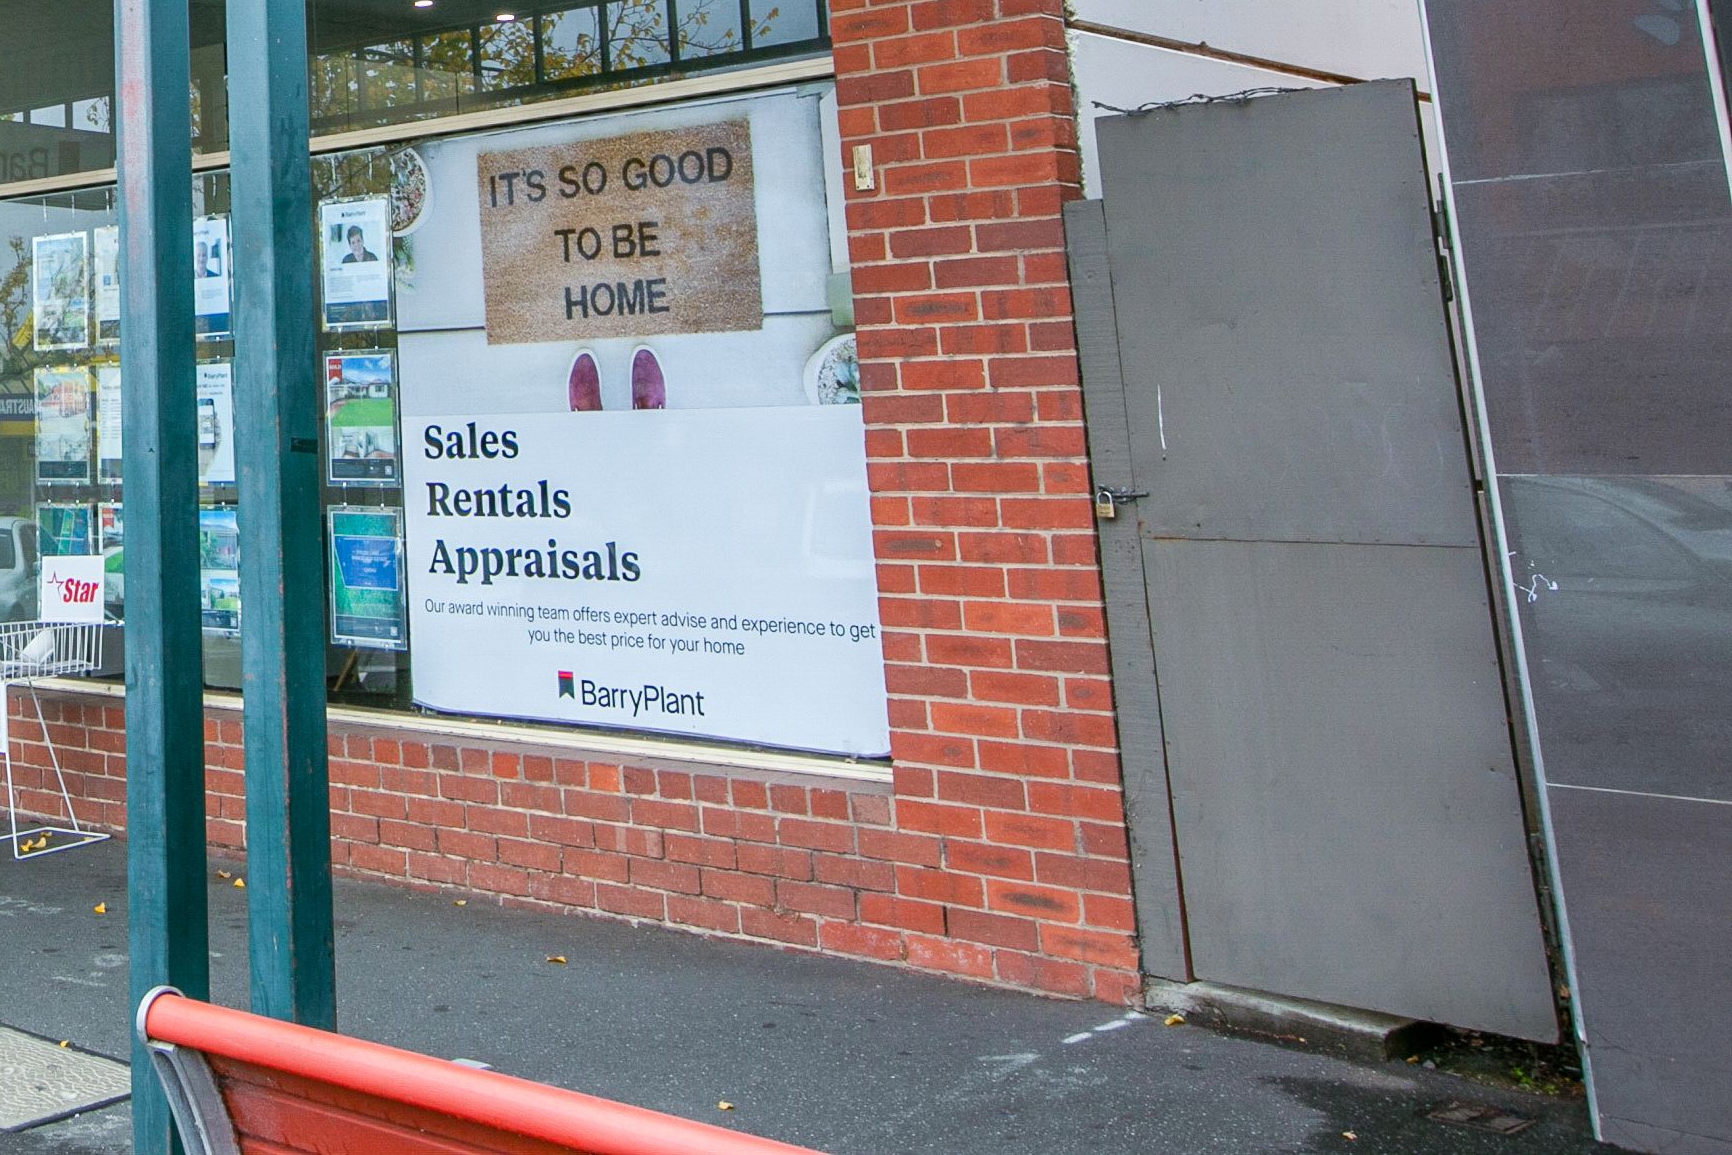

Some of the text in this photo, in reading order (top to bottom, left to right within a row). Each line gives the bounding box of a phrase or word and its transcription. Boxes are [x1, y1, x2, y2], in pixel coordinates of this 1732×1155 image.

[489, 146, 733, 208] IT'S SO GOOD
[554, 222, 661, 263] TO BE
[564, 277, 669, 321] HOME
[424, 422, 519, 460] Sales
[426, 479, 572, 519] Rentals
[428, 538, 641, 585] Appraisals
[63, 578, 99, 603] Star
[425, 598, 876, 642] Our award winning team offers expert advise and experience to get
[528, 628, 745, 655] you the best price for your home
[580, 679, 705, 718] BarryPlant
